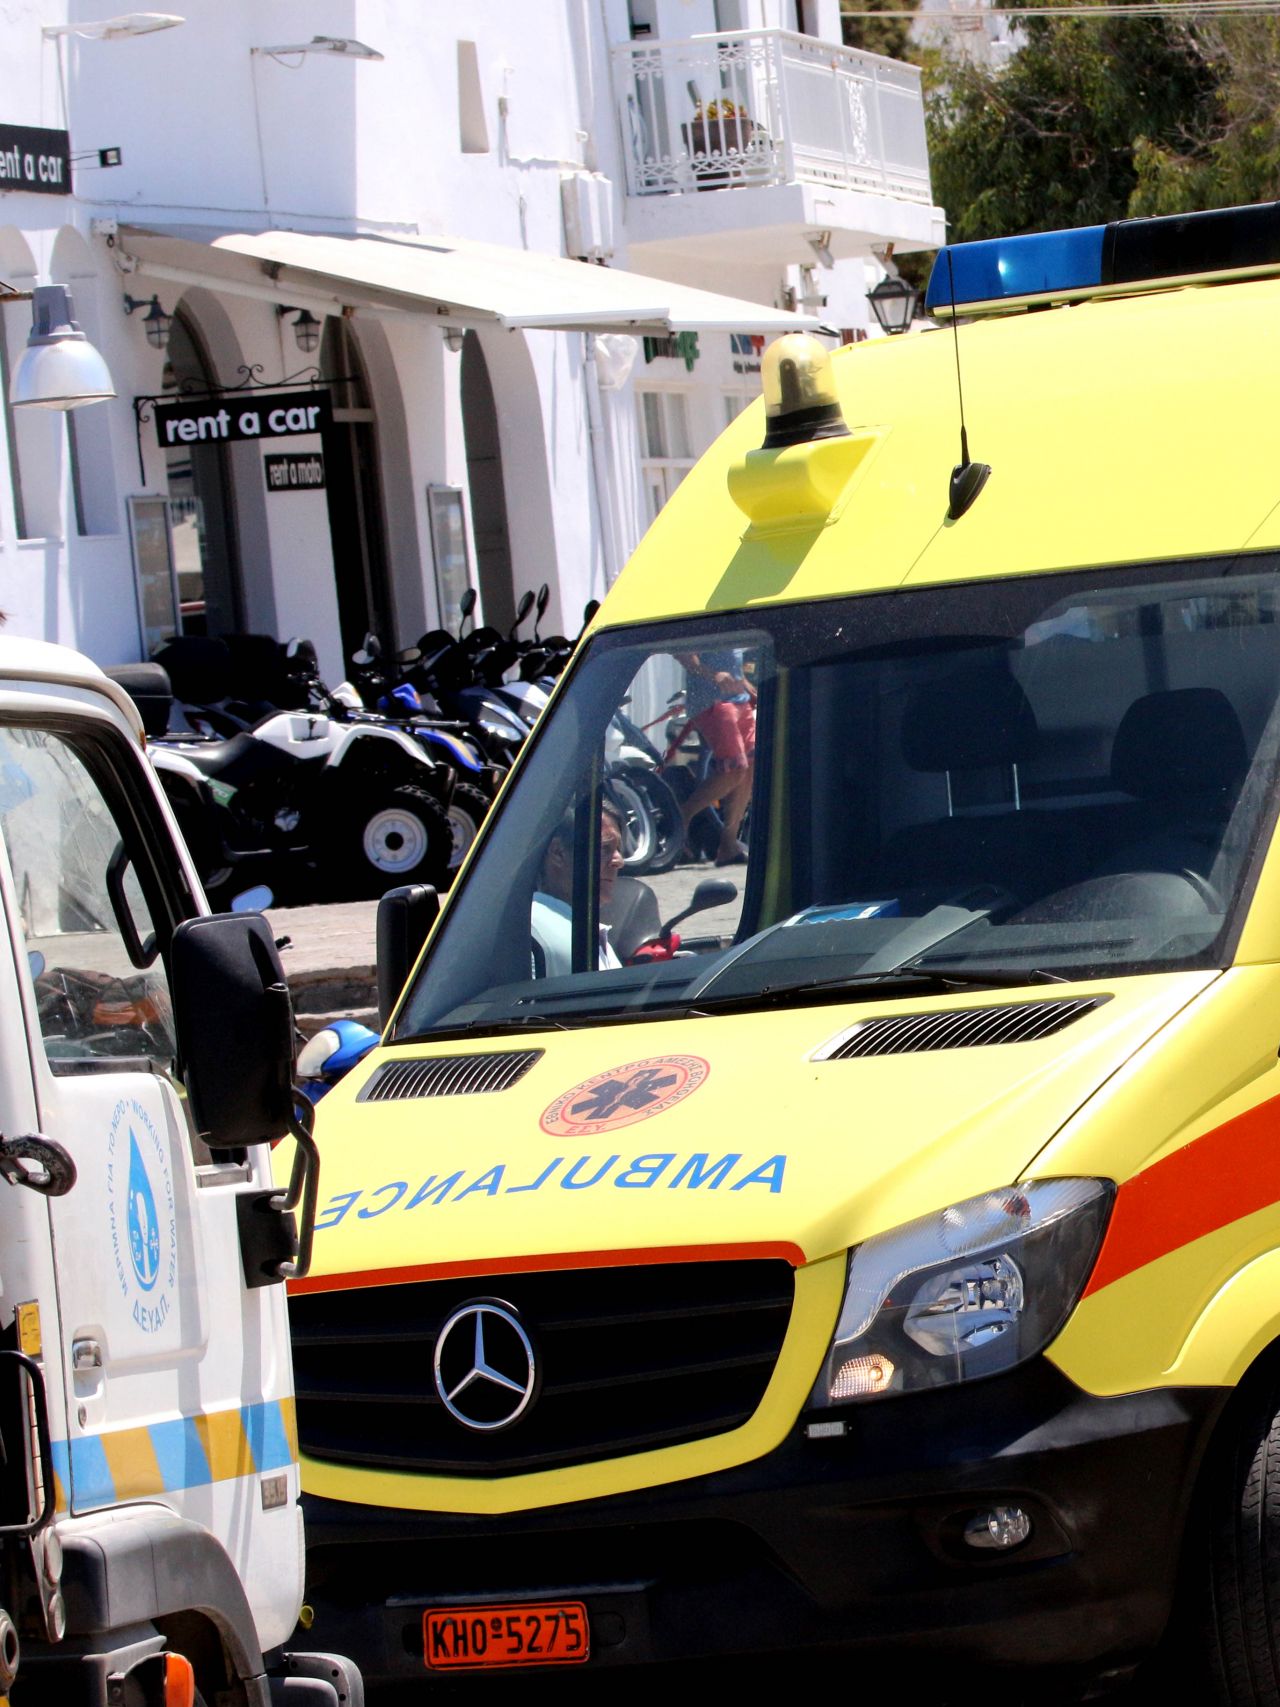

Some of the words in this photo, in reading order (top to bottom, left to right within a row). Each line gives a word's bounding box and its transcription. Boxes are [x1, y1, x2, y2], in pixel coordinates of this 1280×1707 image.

[0, 145, 20, 178] ent
[24, 153, 34, 181] a
[39, 154, 62, 183] car
[165, 409, 231, 442] rent
[238, 411, 261, 435] a
[268, 406, 321, 433] car
[269, 457, 289, 486] rent
[290, 462, 298, 485] a
[131, 1097, 164, 1164] WORKING
[168, 1219, 177, 1289] WATER
